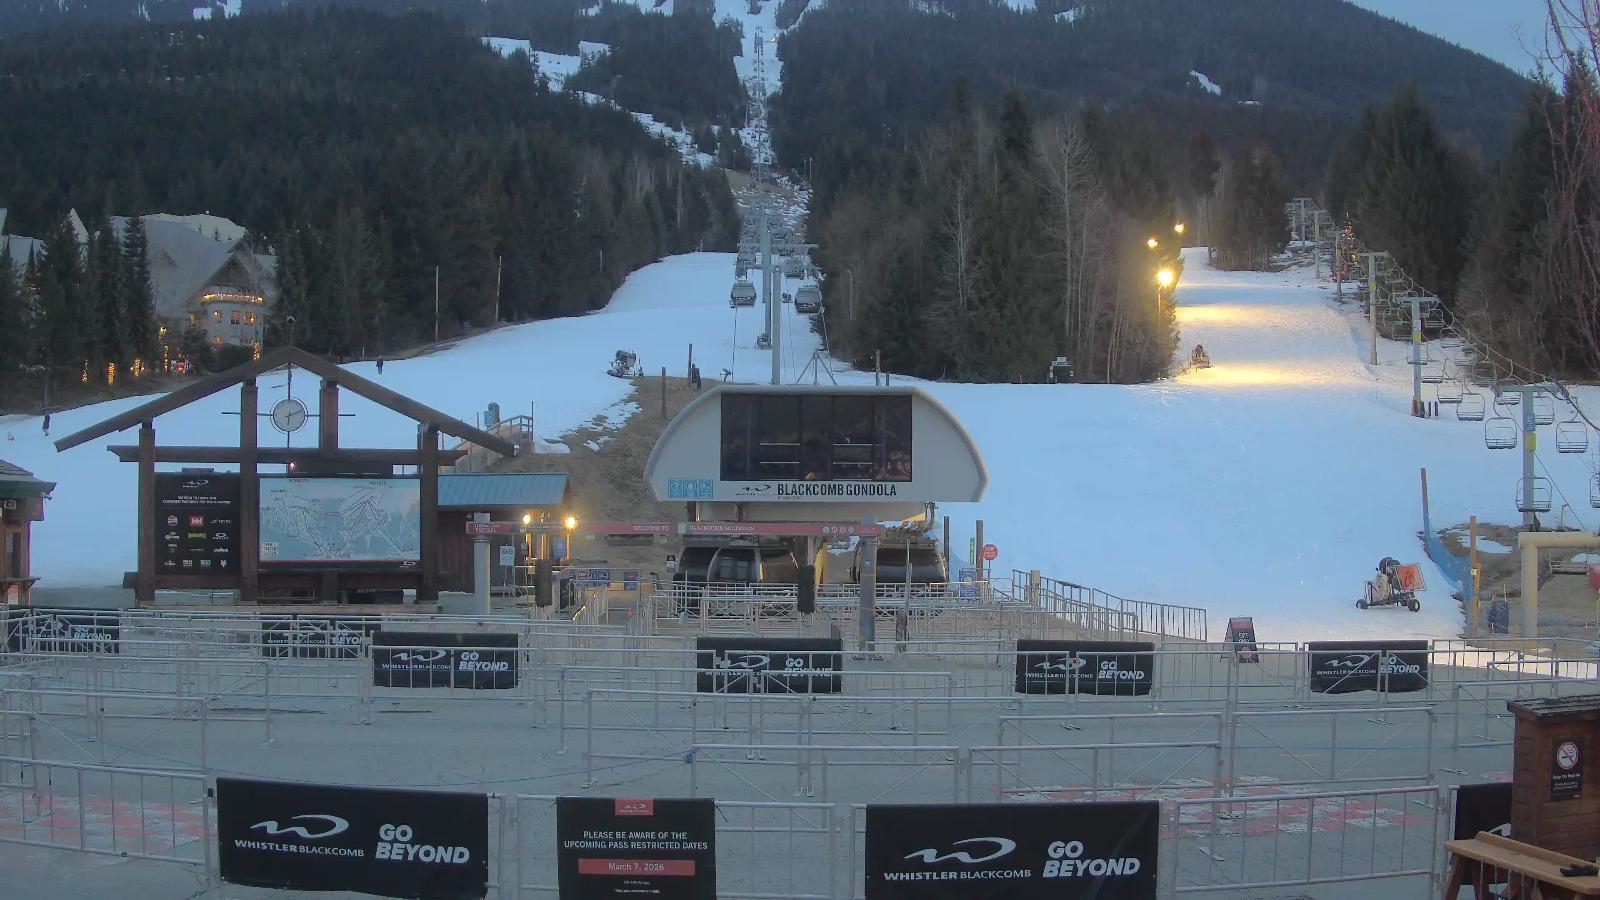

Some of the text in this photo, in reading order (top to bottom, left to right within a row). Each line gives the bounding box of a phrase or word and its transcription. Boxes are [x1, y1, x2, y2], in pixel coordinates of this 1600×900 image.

[777, 483, 897, 496] BLACKCOMB GONDOLA
[460, 651, 480, 661] GO
[459, 660, 509, 671] BEYOND
[785, 657, 804, 668] GO
[1100, 660, 1117, 670] GO
[1098, 669, 1144, 680] BEYOND
[1380, 664, 1420, 674] BEYOND
[379, 823, 413, 842] GO
[583, 830, 688, 840] PLEASE BE AWARE OF THE
[234, 839, 364, 857] WHISTLER BLACKCOMB
[564, 840, 708, 850] UPCOMING PASS RESTRICTED DATES
[1047, 840, 1084, 858] GO
[375, 841, 470, 864] BEYOND
[608, 862, 632, 871] March
[644, 863, 665, 871] 2026
[1042, 857, 1141, 878] BEYOND
[884, 869, 1032, 881] WHISTLER BLACKCOMB
